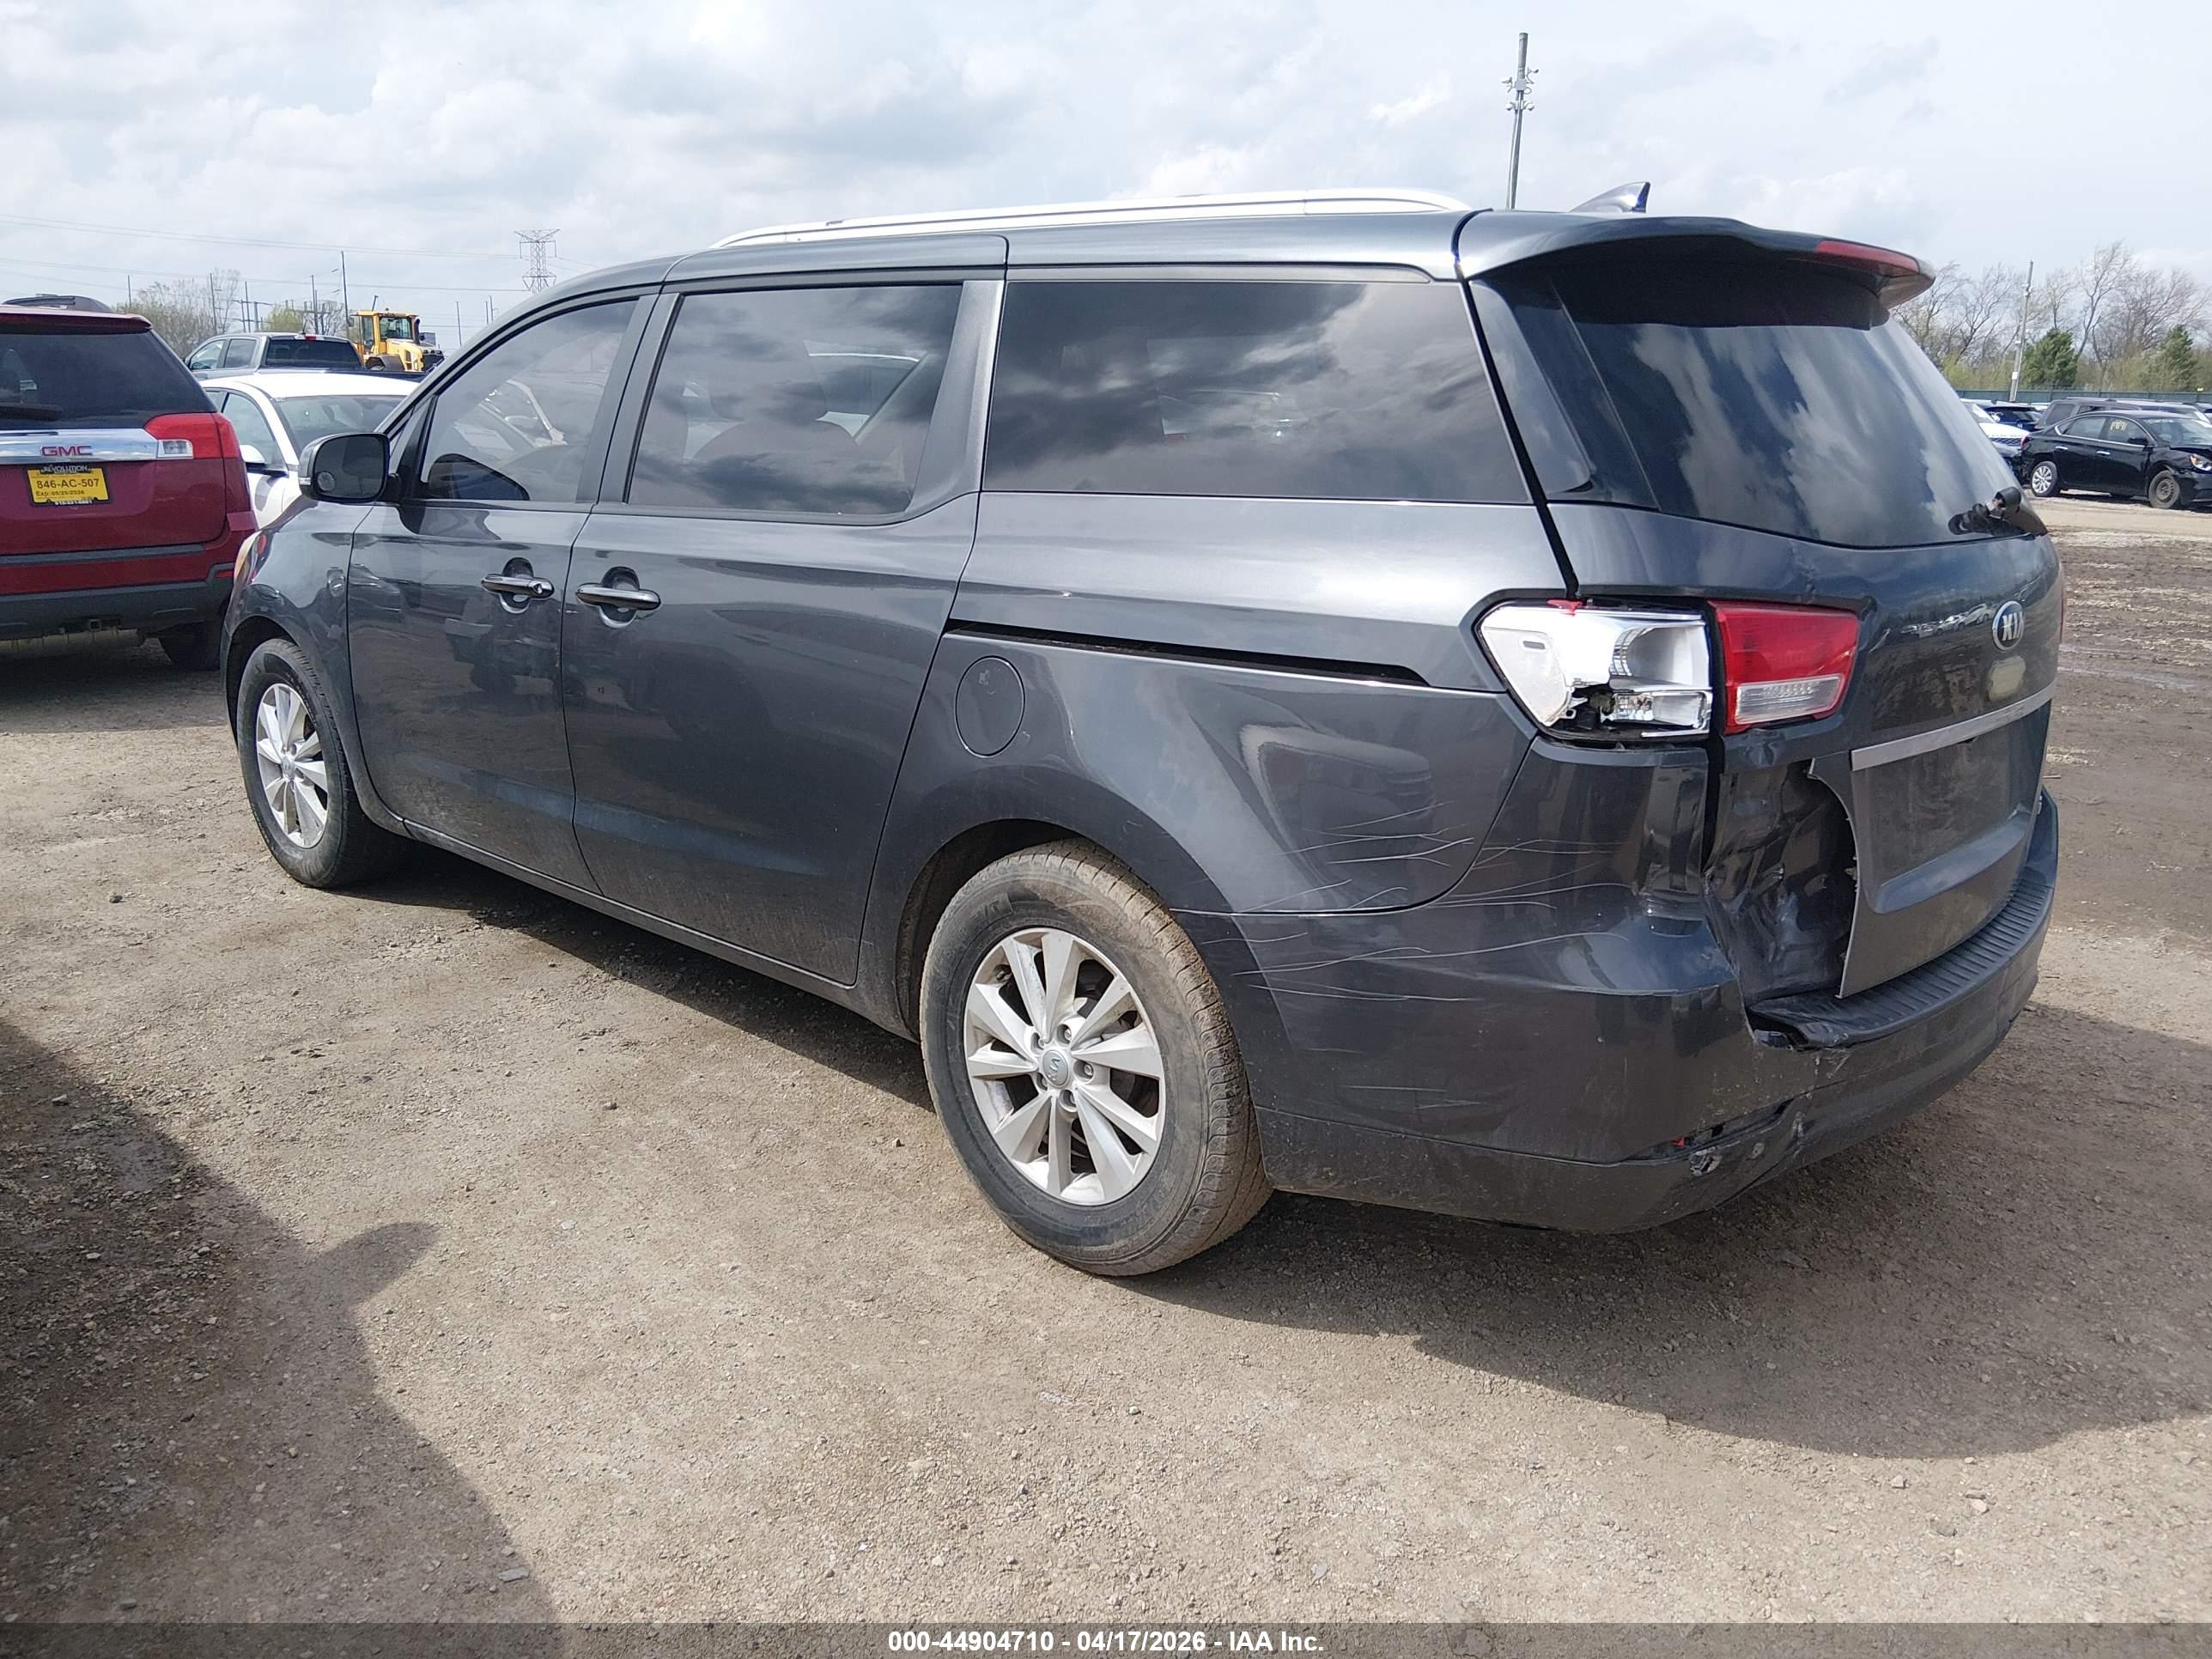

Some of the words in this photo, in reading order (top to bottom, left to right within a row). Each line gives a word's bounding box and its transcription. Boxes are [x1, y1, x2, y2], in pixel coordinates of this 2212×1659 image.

[40, 445, 93, 456] GMC
[36, 478, 100, 489] 846-AC-507
[2002, 611, 2024, 641] KIA
